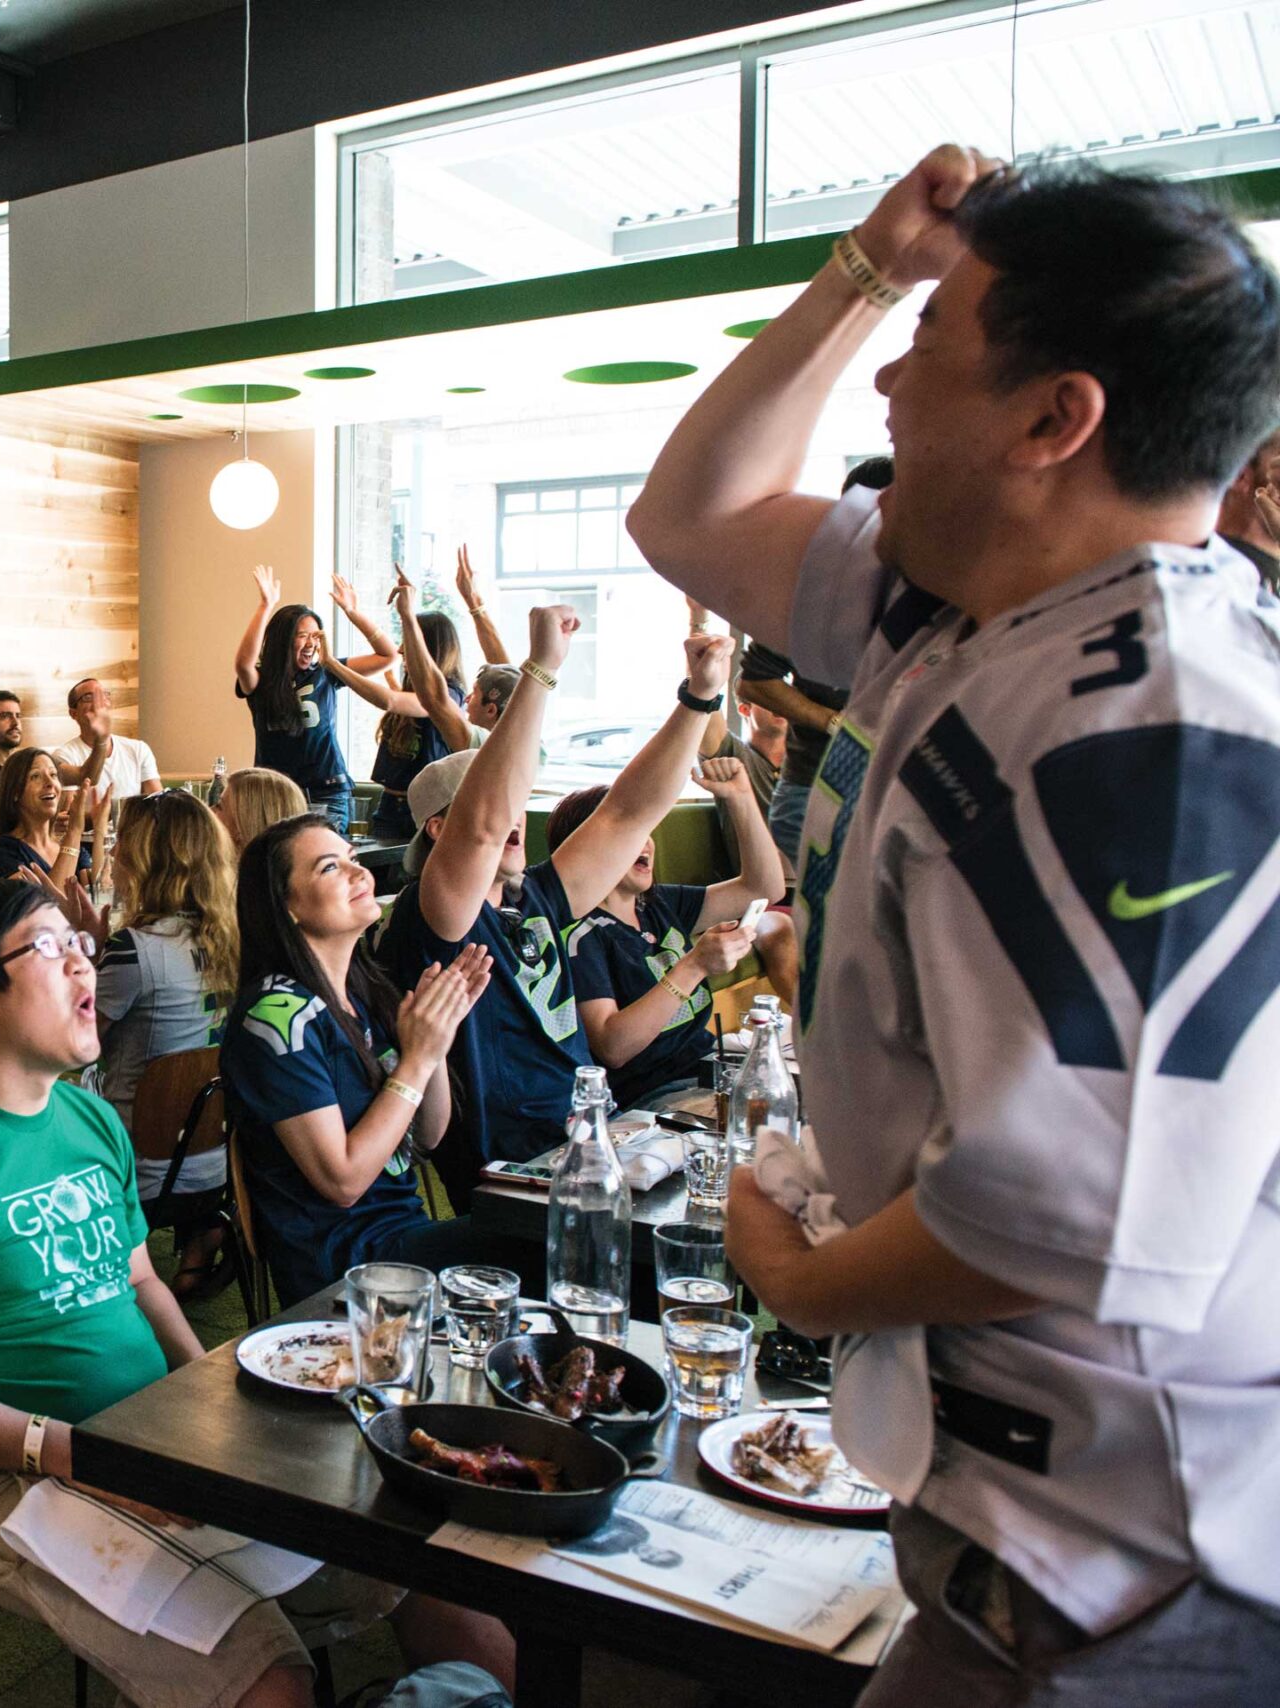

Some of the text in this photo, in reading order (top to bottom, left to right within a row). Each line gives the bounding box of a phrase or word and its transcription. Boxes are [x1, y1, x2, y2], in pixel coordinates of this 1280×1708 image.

[1070, 608, 1150, 698] 3
[919, 736, 979, 821] HAWKS
[8, 1171, 113, 1237] GROW
[29, 1215, 123, 1276] YOUR
[713, 1564, 766, 1600] THIRST
